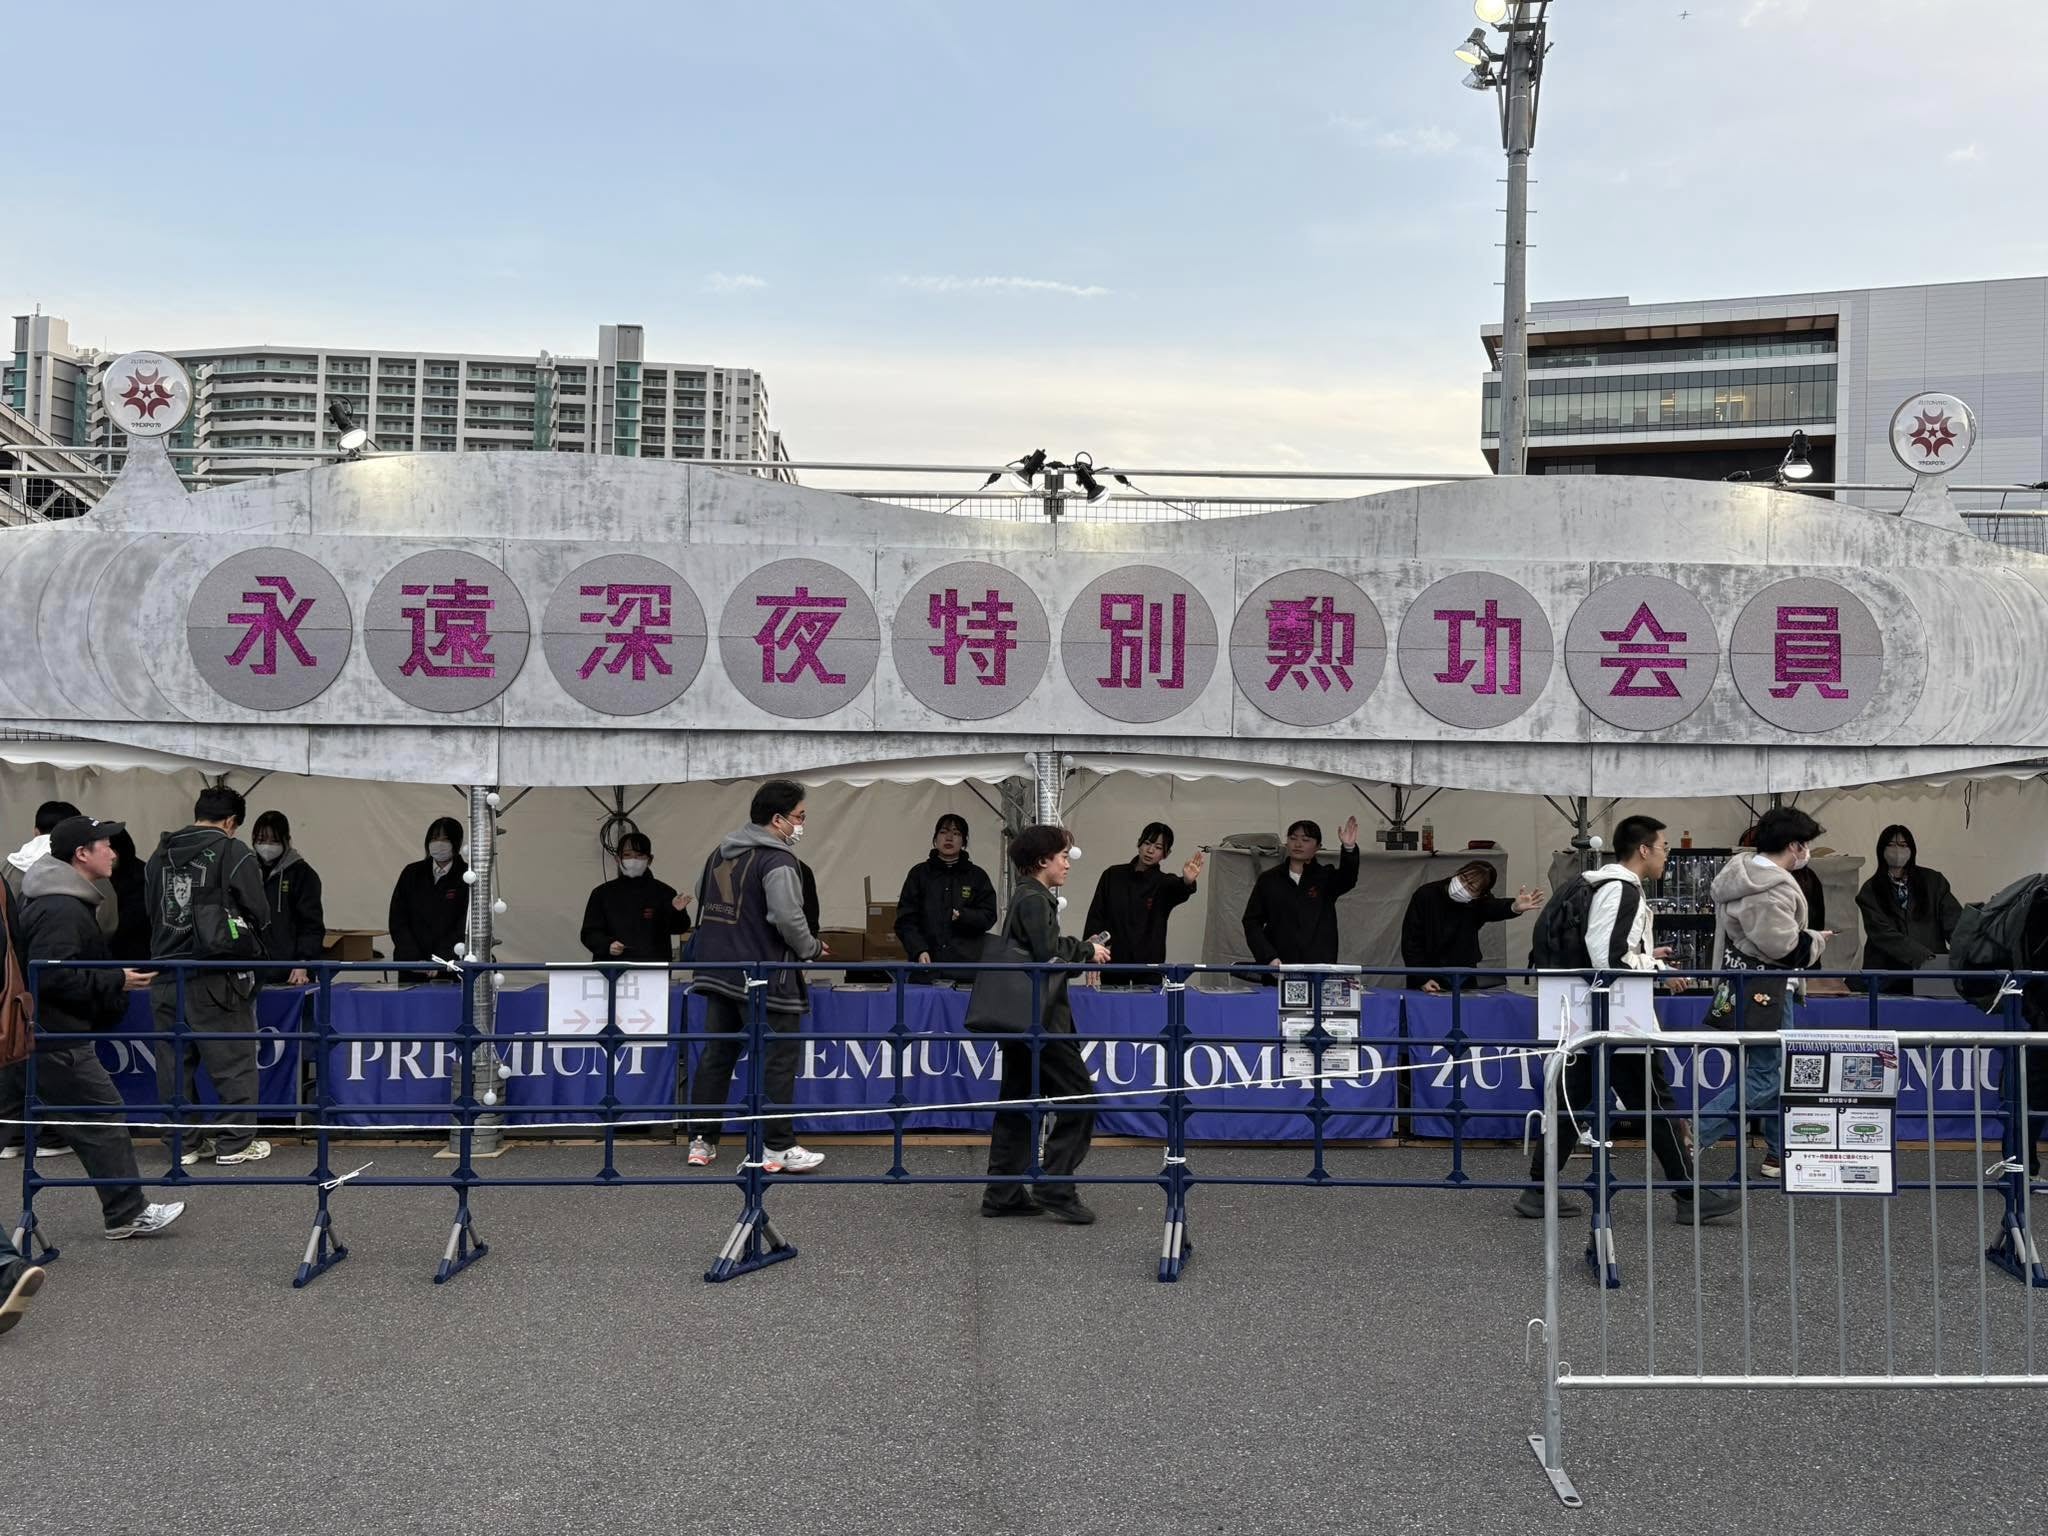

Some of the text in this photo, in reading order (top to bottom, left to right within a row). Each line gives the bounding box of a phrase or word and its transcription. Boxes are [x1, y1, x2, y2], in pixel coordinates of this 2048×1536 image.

[224, 575, 1849, 699] 永遠深夜特別勲功会員
[731, 1031, 1003, 1081] EMIUM
[1430, 1043, 1732, 1090] ZUTYO
[1787, 1041, 1829, 1052] ZUTOMAYO
